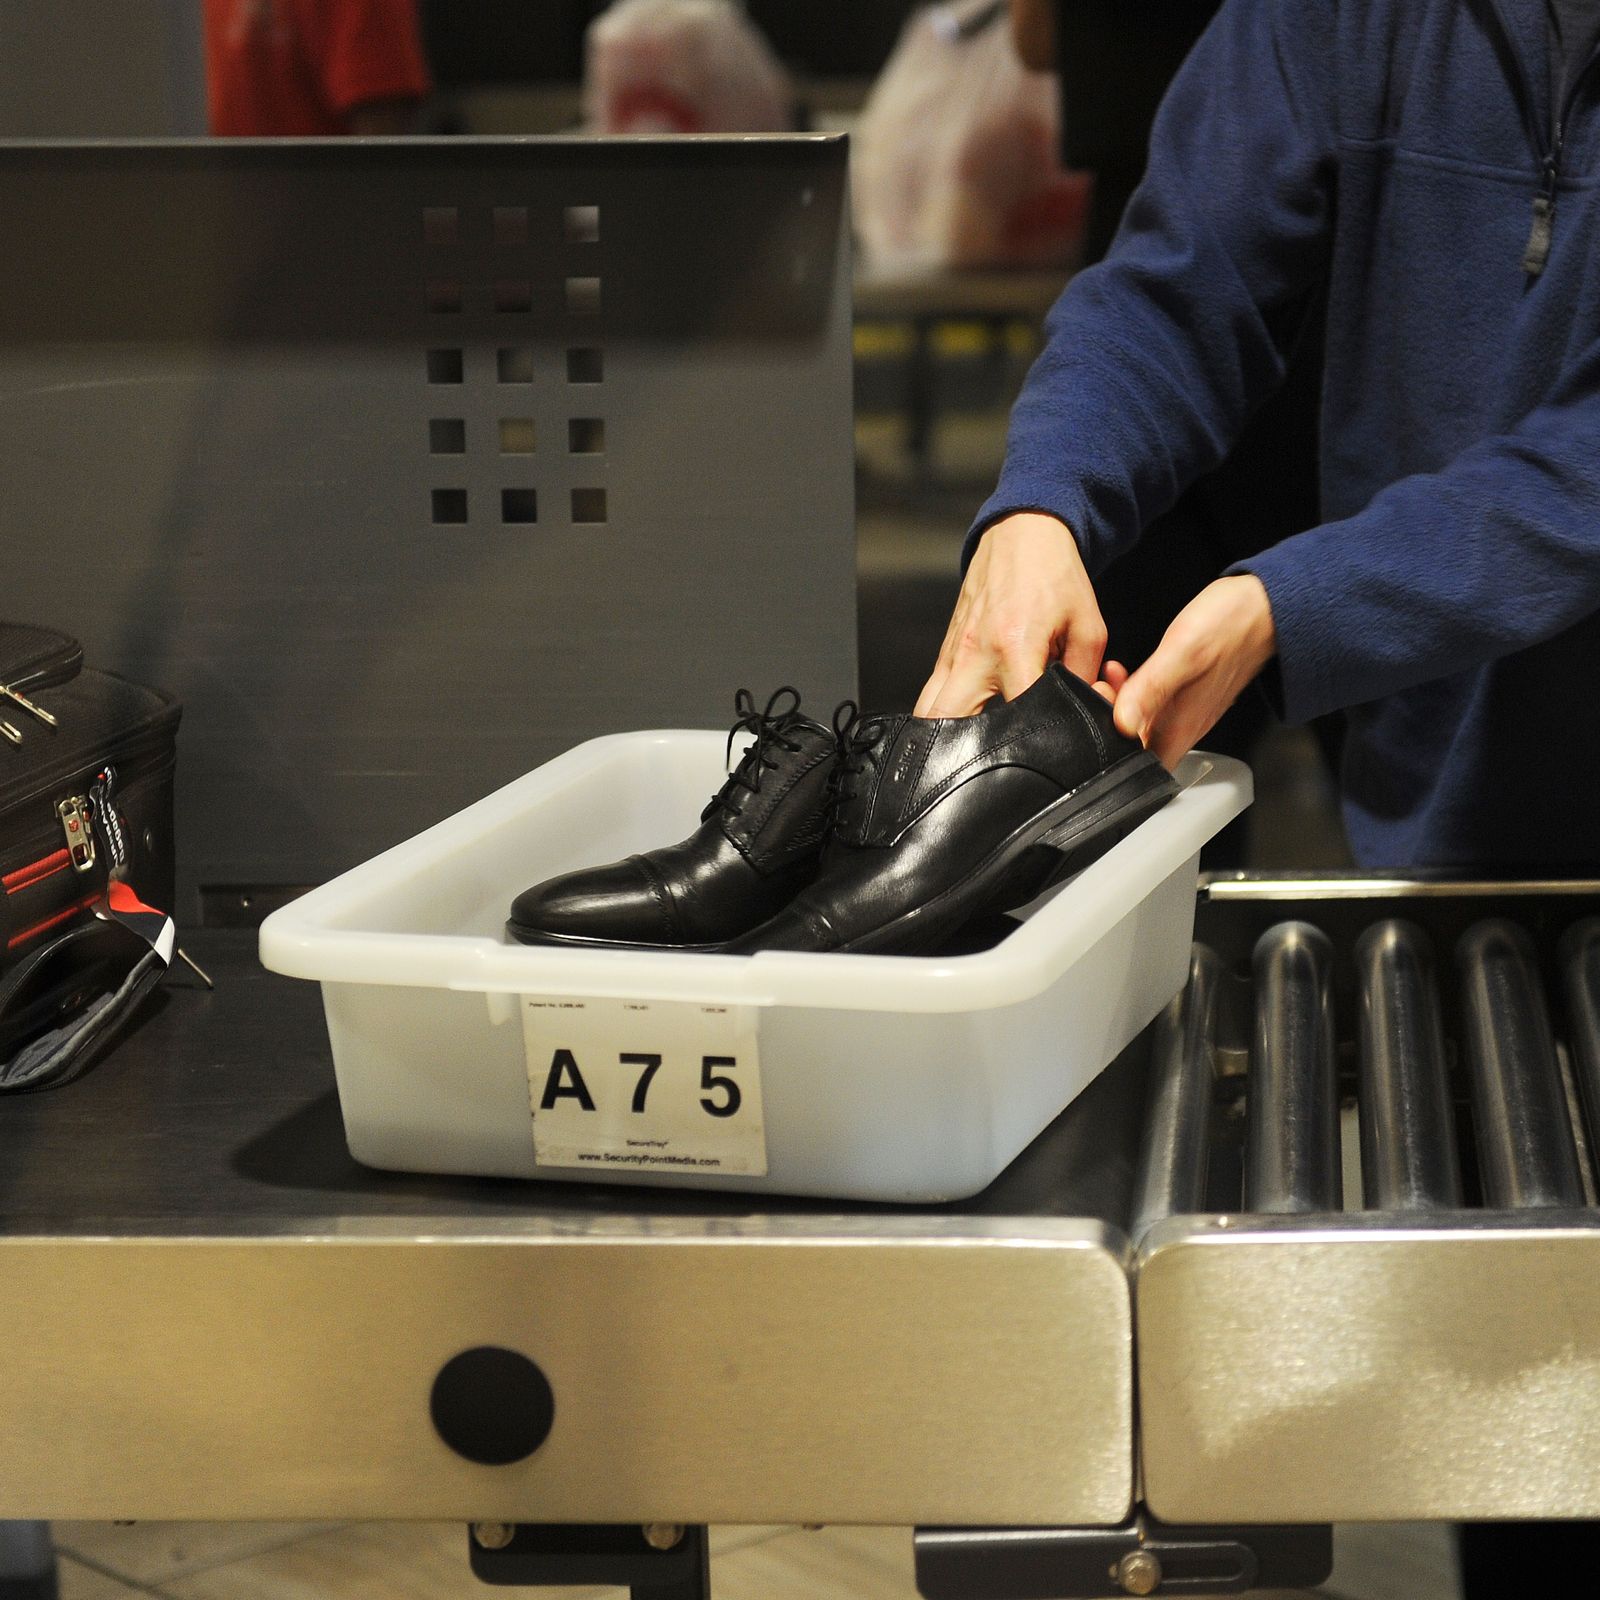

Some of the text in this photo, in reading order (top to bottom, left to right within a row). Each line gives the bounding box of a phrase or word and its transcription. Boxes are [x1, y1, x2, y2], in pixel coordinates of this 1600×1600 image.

[540, 1049, 742, 1117] A 7 5
[578, 1152, 720, 1167] www.SecurityPointMedia.com
